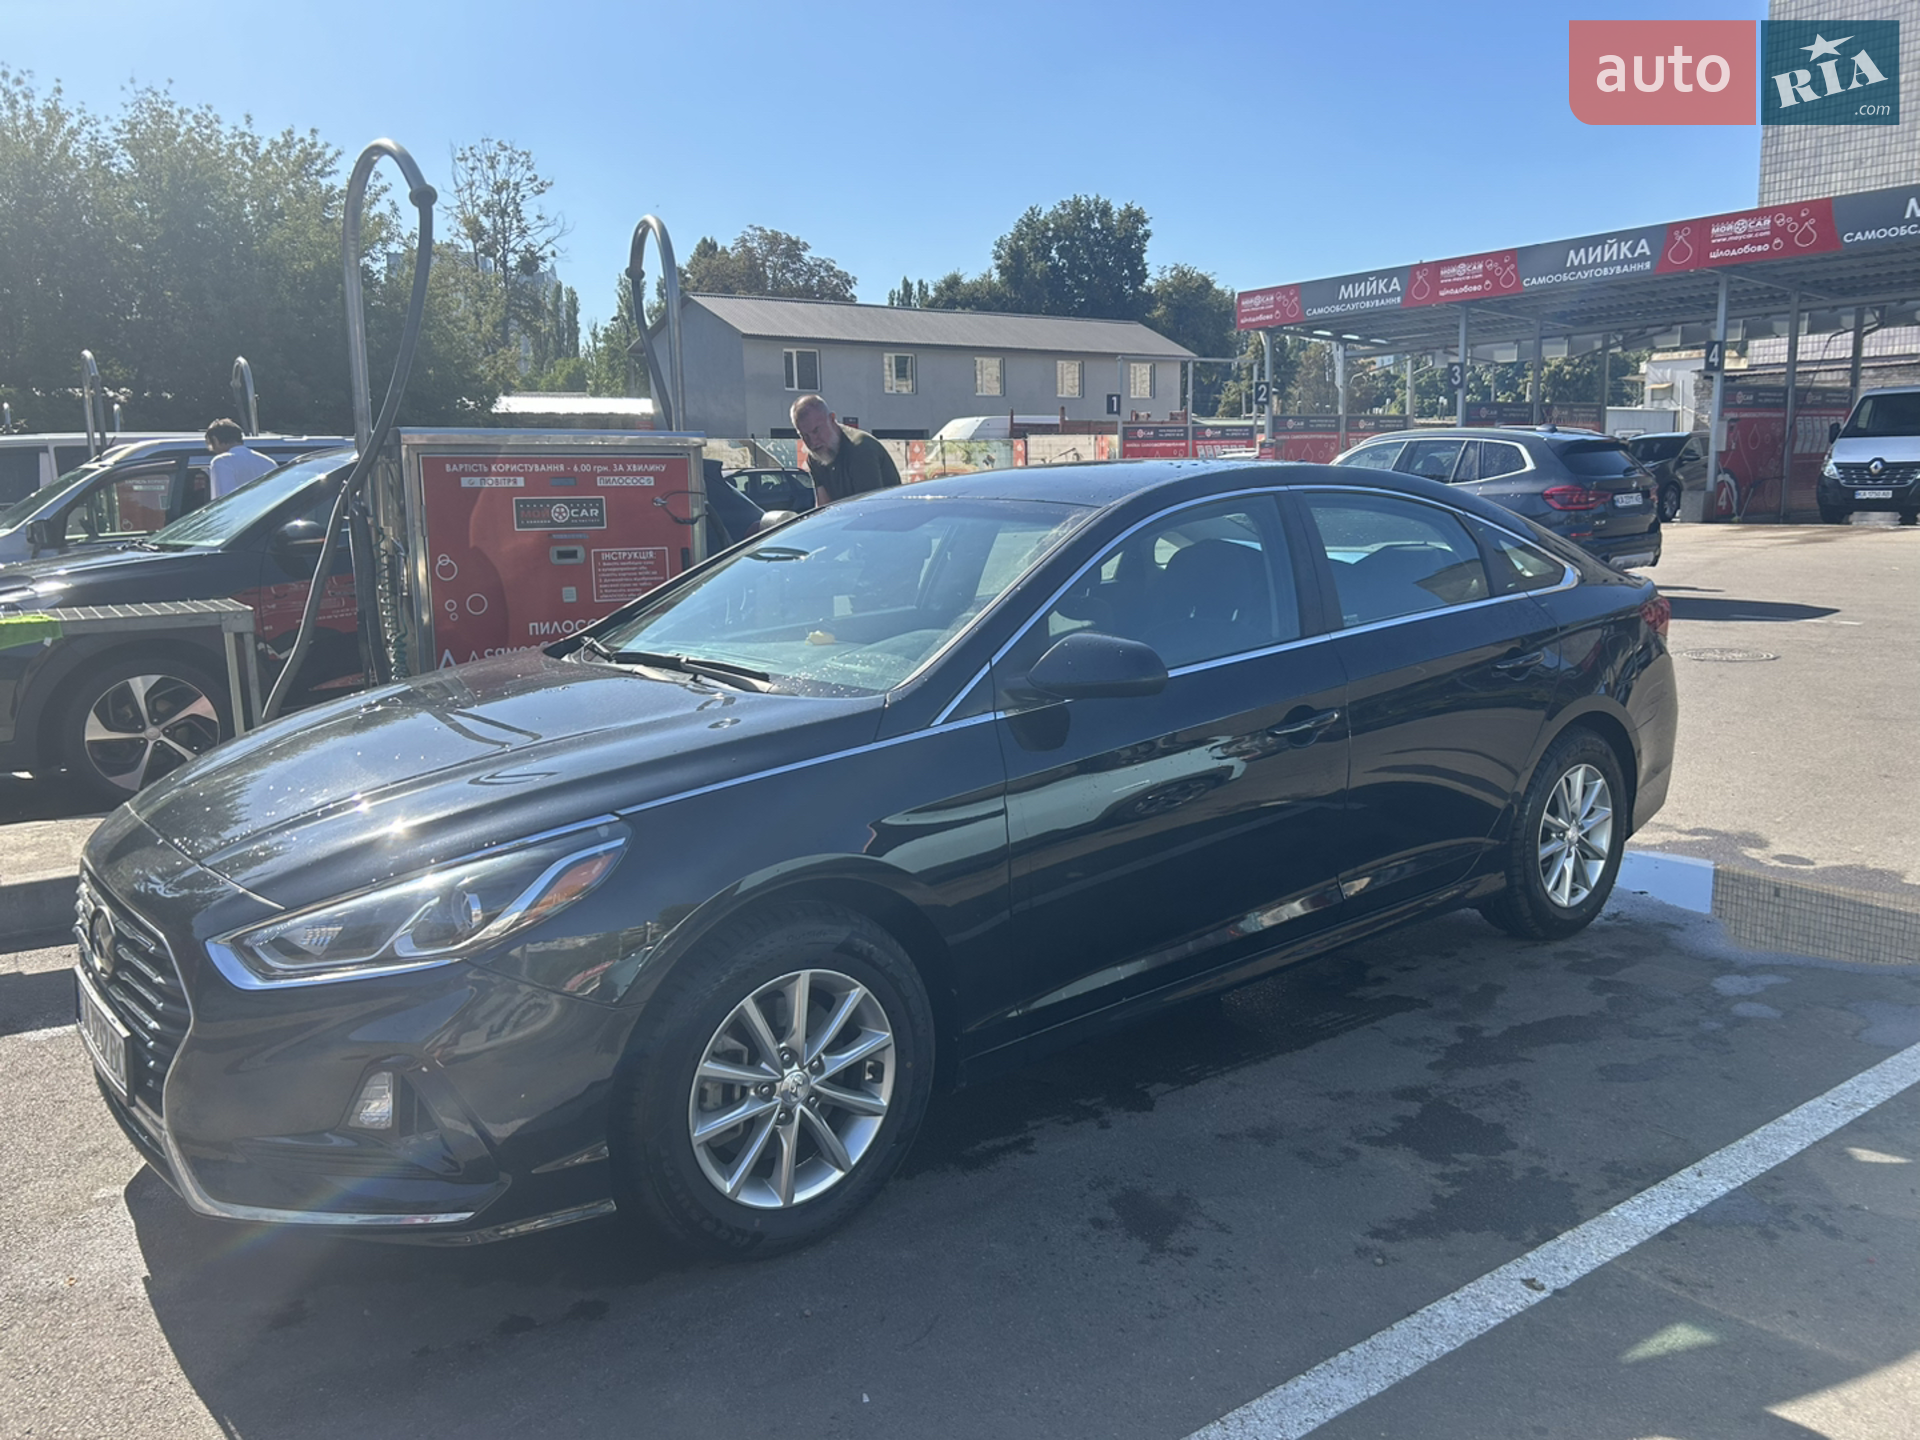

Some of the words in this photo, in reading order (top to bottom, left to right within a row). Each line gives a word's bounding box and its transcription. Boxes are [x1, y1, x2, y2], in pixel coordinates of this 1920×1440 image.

[1843, 223, 1920, 244] САМООБС
[1566, 239, 1650, 266] МИЙКА
[1523, 261, 1650, 286] САМООБСЛУГОВУВАННЯ
[1338, 277, 1400, 299] МИЙКА
[1306, 296, 1401, 317] САМООБСЛУГОВУВАННЯ
[1709, 343, 1720, 367] 4
[1451, 365, 1462, 385] 3
[1258, 384, 1267, 402] 2
[445, 463, 488, 473] ВАРТІСТЬ
[490, 463, 565, 473] КОРИСТУВАННЯ
[573, 463, 591, 473] 6,00
[613, 463, 625, 472] ЗА
[626, 463, 667, 473] ХВИЛИНУ
[480, 478, 518, 487] ПОВІТРЯ
[599, 476, 645, 485] ПИЛОСОС
[570, 508, 600, 518] CAR
